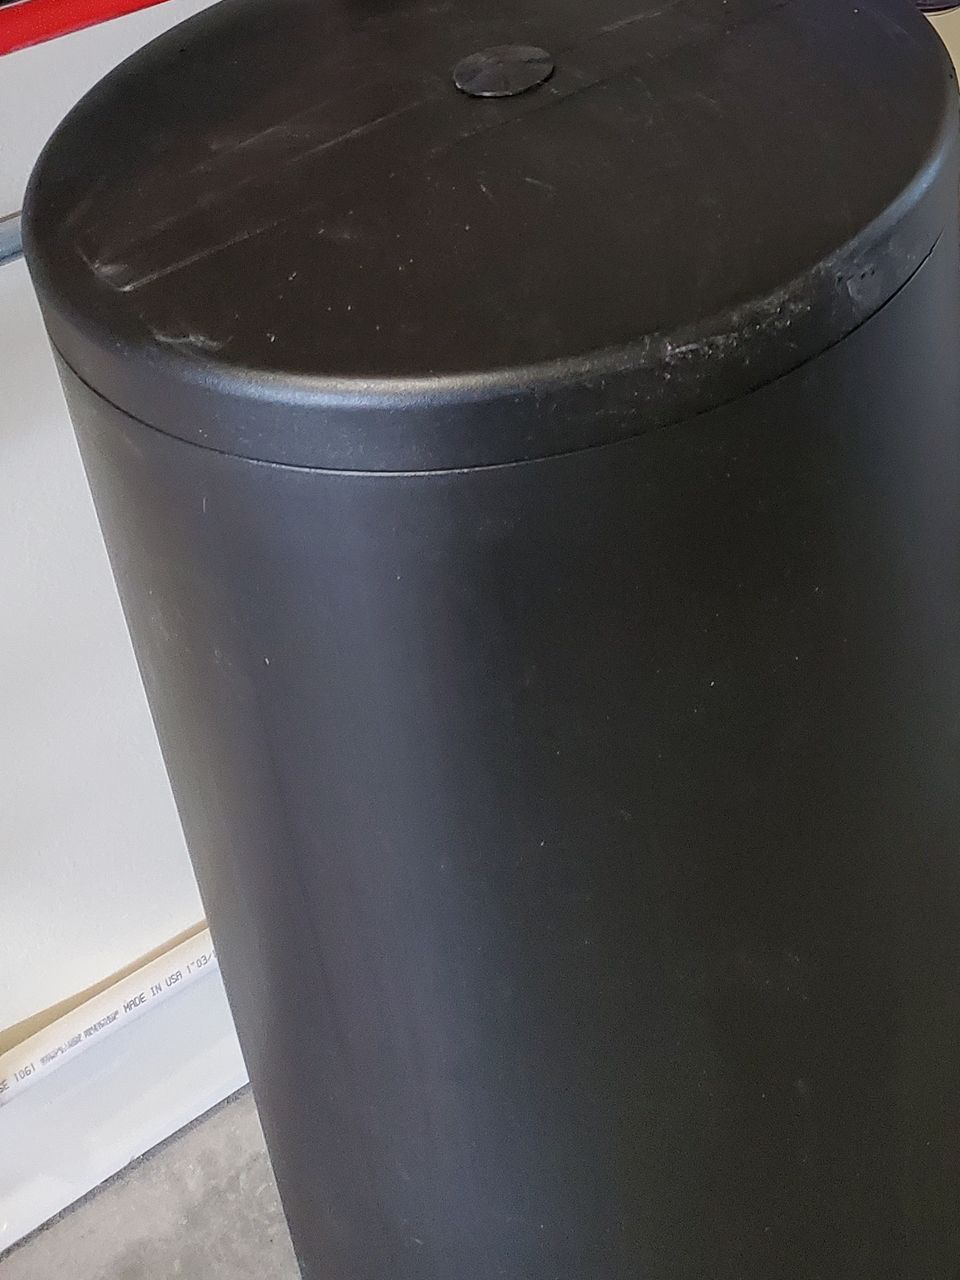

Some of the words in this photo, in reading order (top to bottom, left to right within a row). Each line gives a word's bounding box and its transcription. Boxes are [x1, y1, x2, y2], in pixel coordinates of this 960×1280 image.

[123, 992, 147, 1014] MADE
[150, 982, 163, 997] IN
[165, 970, 183, 987] USA
